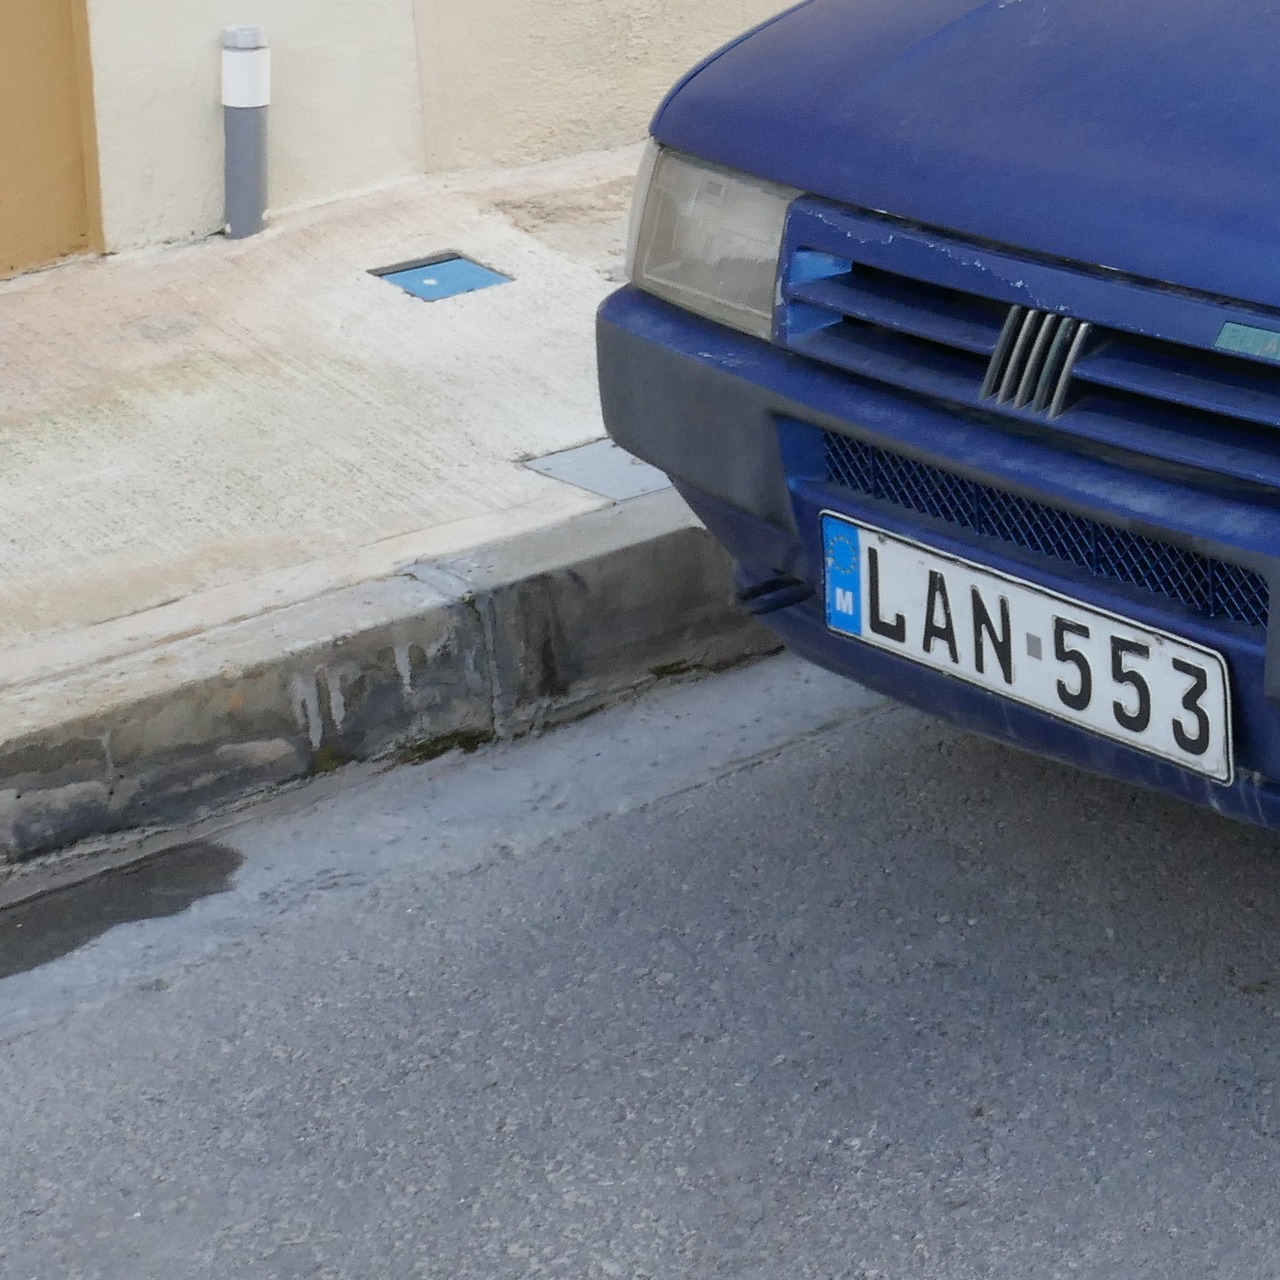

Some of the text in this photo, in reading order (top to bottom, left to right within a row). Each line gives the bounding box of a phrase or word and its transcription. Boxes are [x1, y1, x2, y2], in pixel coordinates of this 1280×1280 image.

[835, 586, 854, 616] M
[868, 546, 1210, 755] LAN 553
